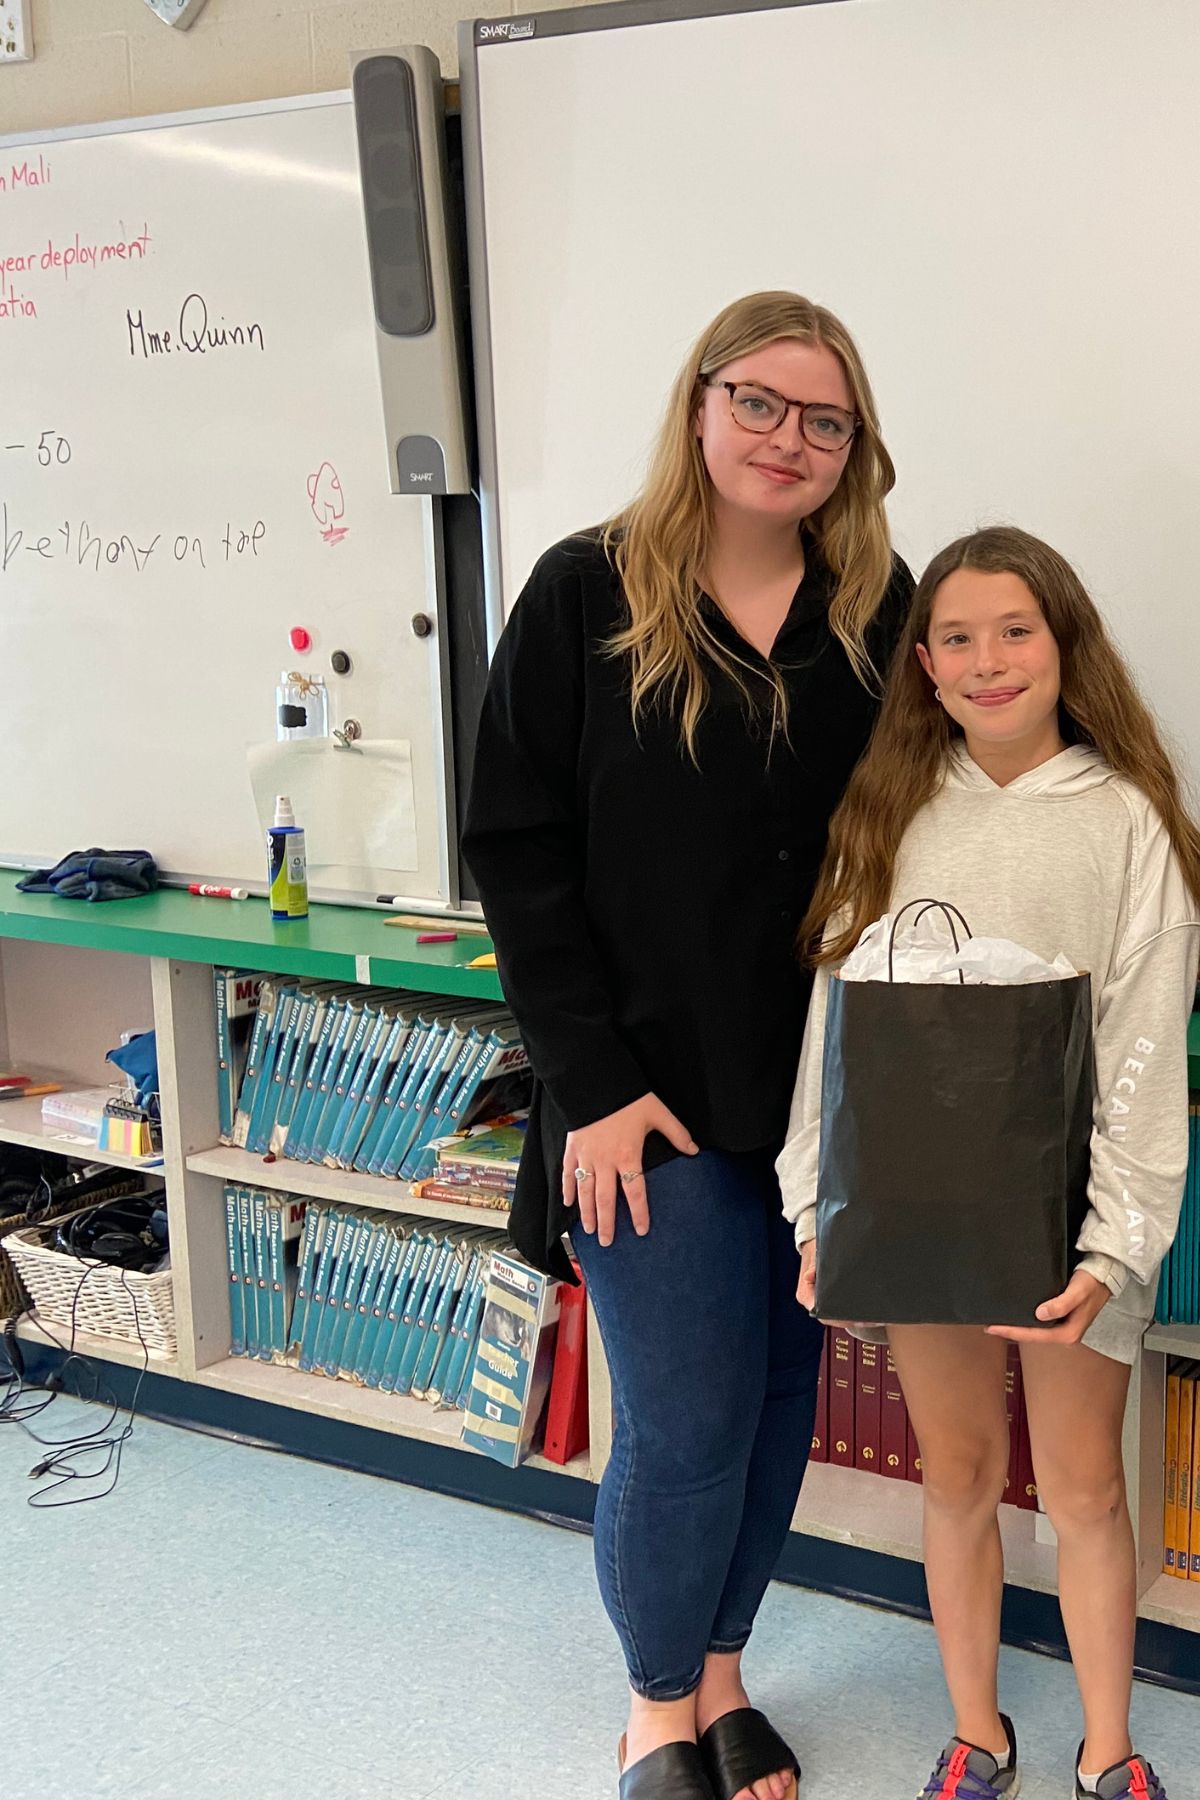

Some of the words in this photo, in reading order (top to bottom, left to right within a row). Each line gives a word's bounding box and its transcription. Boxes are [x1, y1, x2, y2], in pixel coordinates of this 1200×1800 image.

[480, 24, 510, 39] SMART
[12, 154, 51, 189] Mali
[41, 221, 152, 280] deployment
[37, 430, 72, 467] 50
[409, 472, 434, 482] SMART
[174, 534, 206, 569] on
[270, 1210, 280, 1232] ath
[493, 1260, 514, 1280] Math
